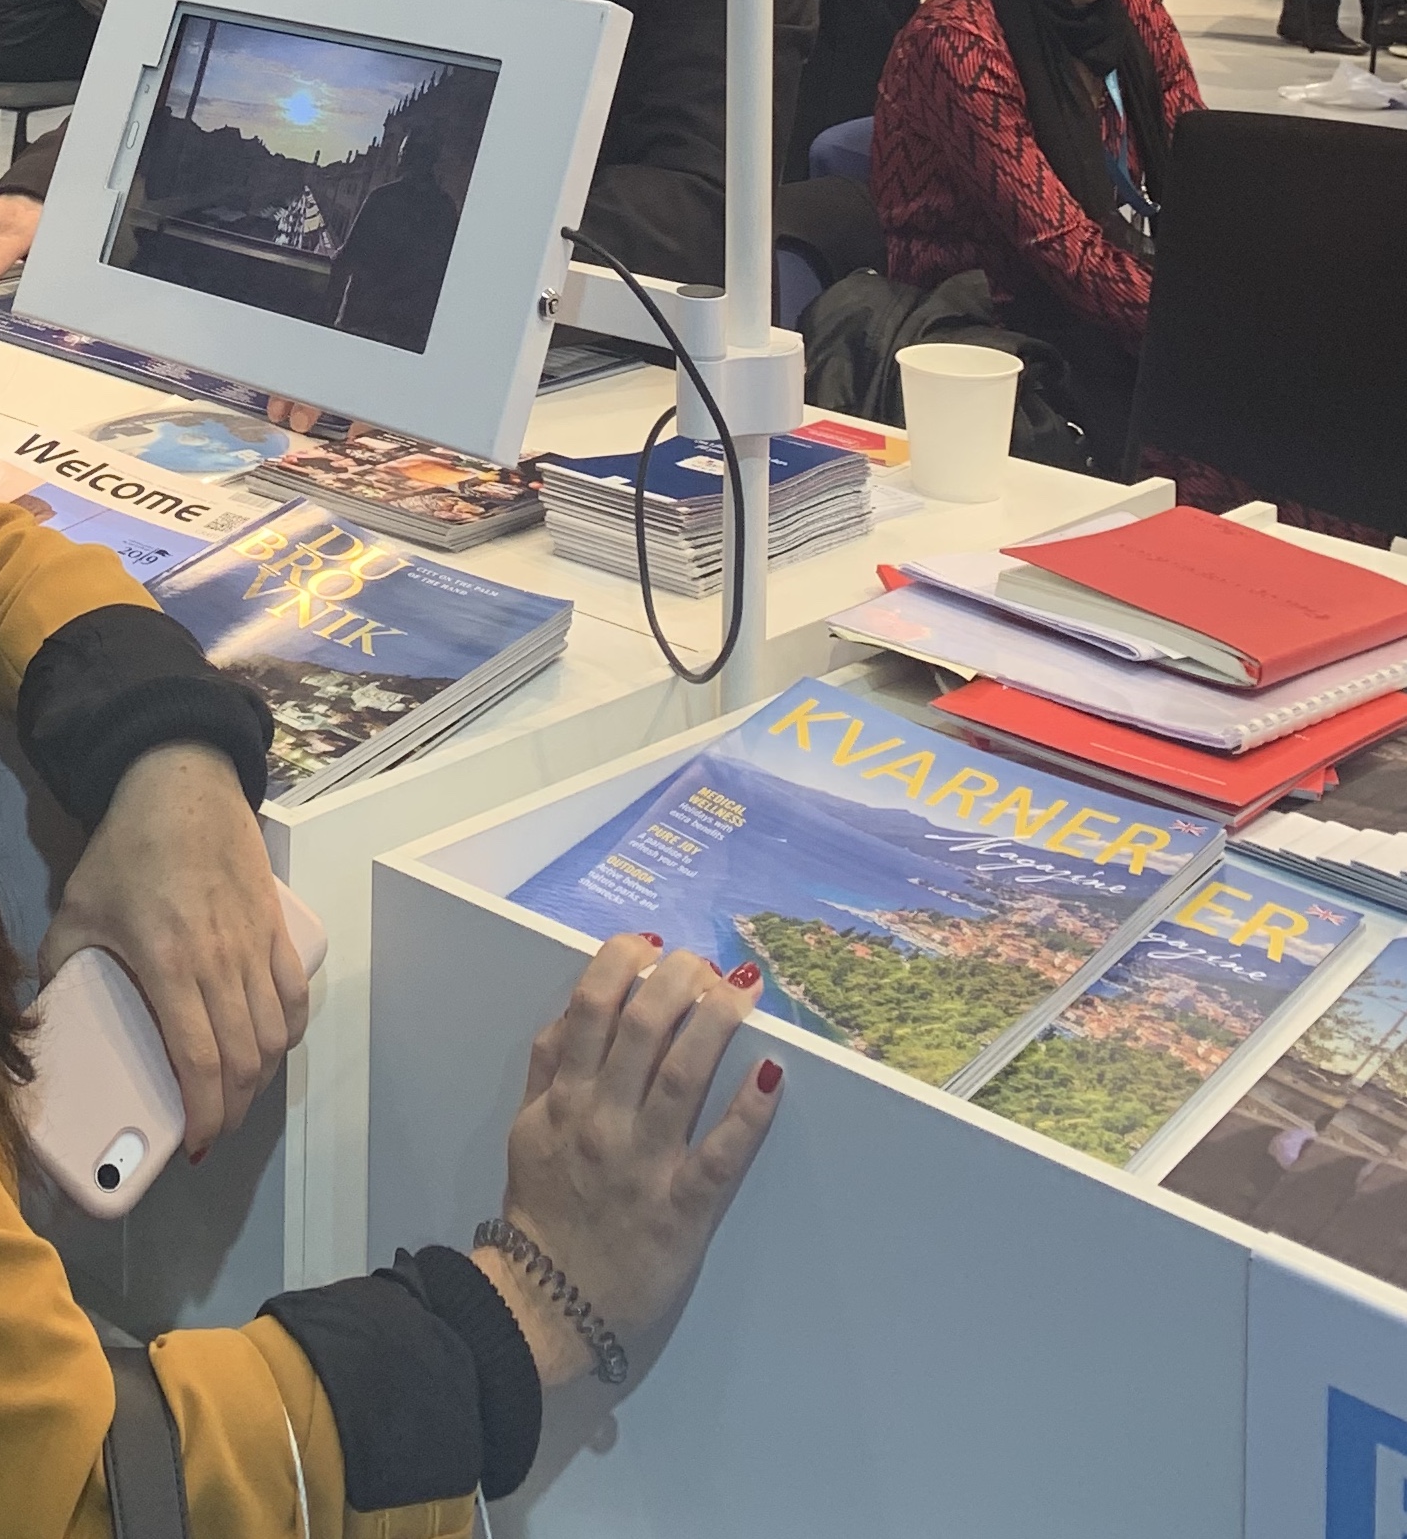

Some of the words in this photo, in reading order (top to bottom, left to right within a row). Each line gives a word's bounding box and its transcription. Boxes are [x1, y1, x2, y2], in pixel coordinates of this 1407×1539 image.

[13, 432, 211, 523] Welcome
[295, 524, 415, 580] DU
[416, 566, 439, 577] CITY
[438, 574, 452, 582] ON
[454, 579, 473, 589] THE
[474, 585, 499, 597] PALM
[420, 577, 441, 587] THE
[440, 583, 468, 596] HAND
[697, 787, 747, 816] MEDICAL
[768, 697, 1172, 876] KVARNER
[669, 810, 691, 823] extra
[690, 820, 725, 841] benefits
[678, 802, 714, 823] Holidays
[714, 820, 734, 833] with
[688, 794, 747, 828] WELLNESS
[644, 837, 682, 859] paradise
[681, 855, 693, 864] to
[646, 824, 681, 845] PURE
[677, 841, 703, 855] JOY
[606, 855, 656, 884] OUTDOOR
[629, 840, 659, 858] refresh
[657, 855, 679, 867] your
[677, 865, 699, 878] soul
[924, 833, 1127, 895] Magazine
[577, 876, 625, 905] shipwrecks
[587, 870, 616, 888] nature
[613, 885, 640, 901] parks
[639, 899, 660, 911] and
[595, 863, 624, 880] Active
[622, 876, 658, 899] between
